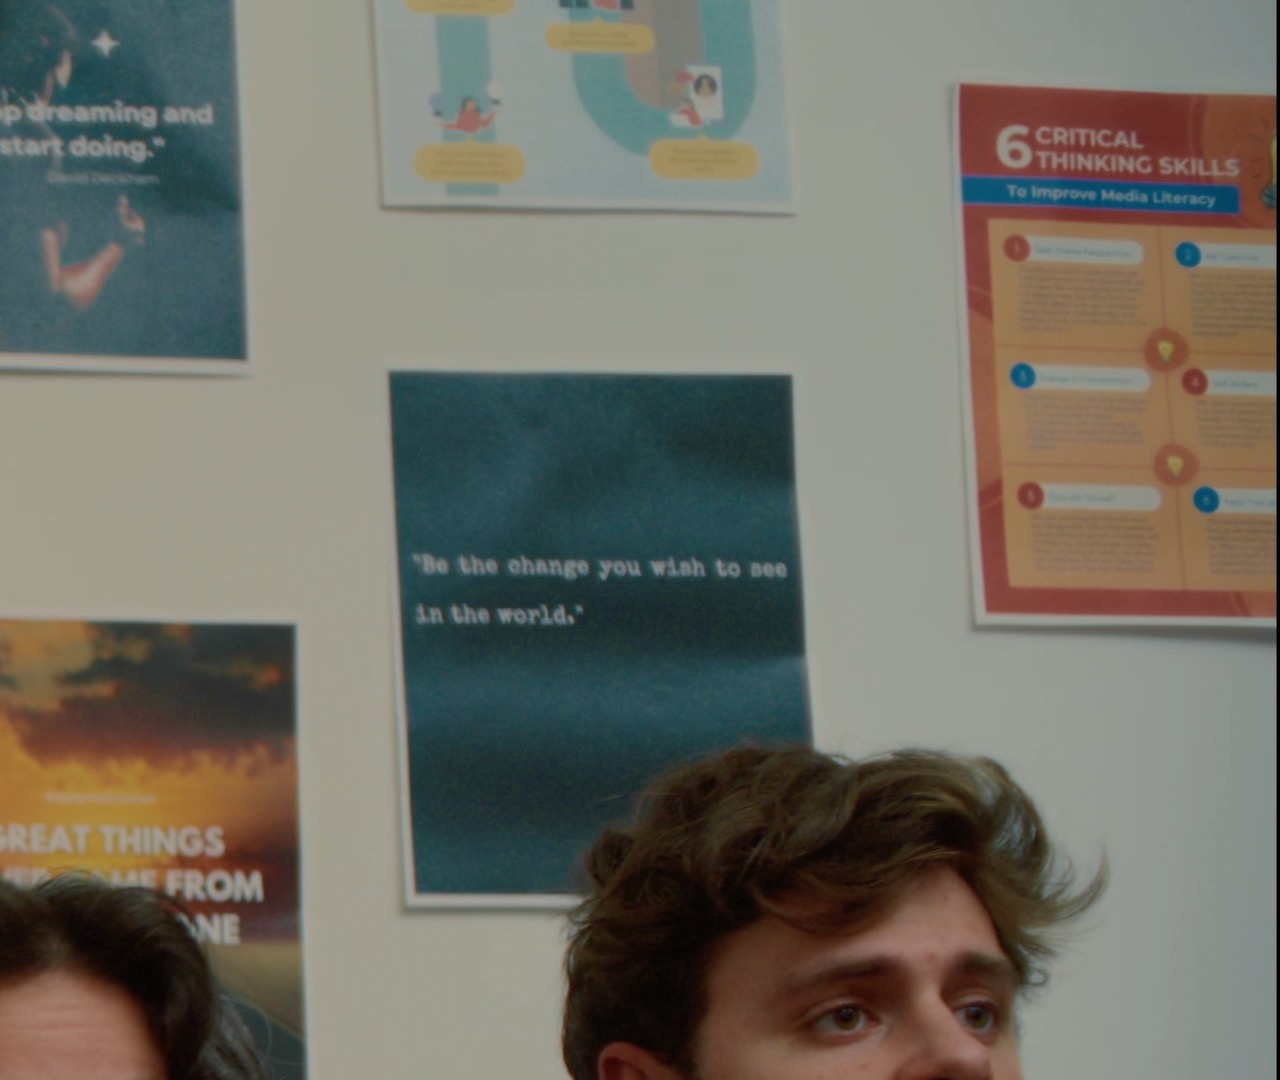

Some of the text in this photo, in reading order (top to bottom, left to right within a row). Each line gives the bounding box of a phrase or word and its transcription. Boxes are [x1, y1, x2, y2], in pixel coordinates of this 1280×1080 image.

[25, 100, 158, 128] dreaming
[163, 103, 214, 125] and
[996, 124, 1032, 169] 6
[1035, 126, 1144, 150] CRITICAL
[1036, 151, 1241, 178] THINKING SKILLS
[1007, 184, 1216, 209] To Improve Media Literacy
[458, 555, 499, 576] the
[508, 556, 590, 580] change
[598, 561, 642, 581] you
[650, 557, 706, 578] wish
[715, 559, 741, 578] to
[750, 563, 788, 578] see
[416, 604, 443, 625] in
[450, 605, 490, 625] the
[99, 825, 226, 857] THINGS
[165, 870, 264, 903] FROM
